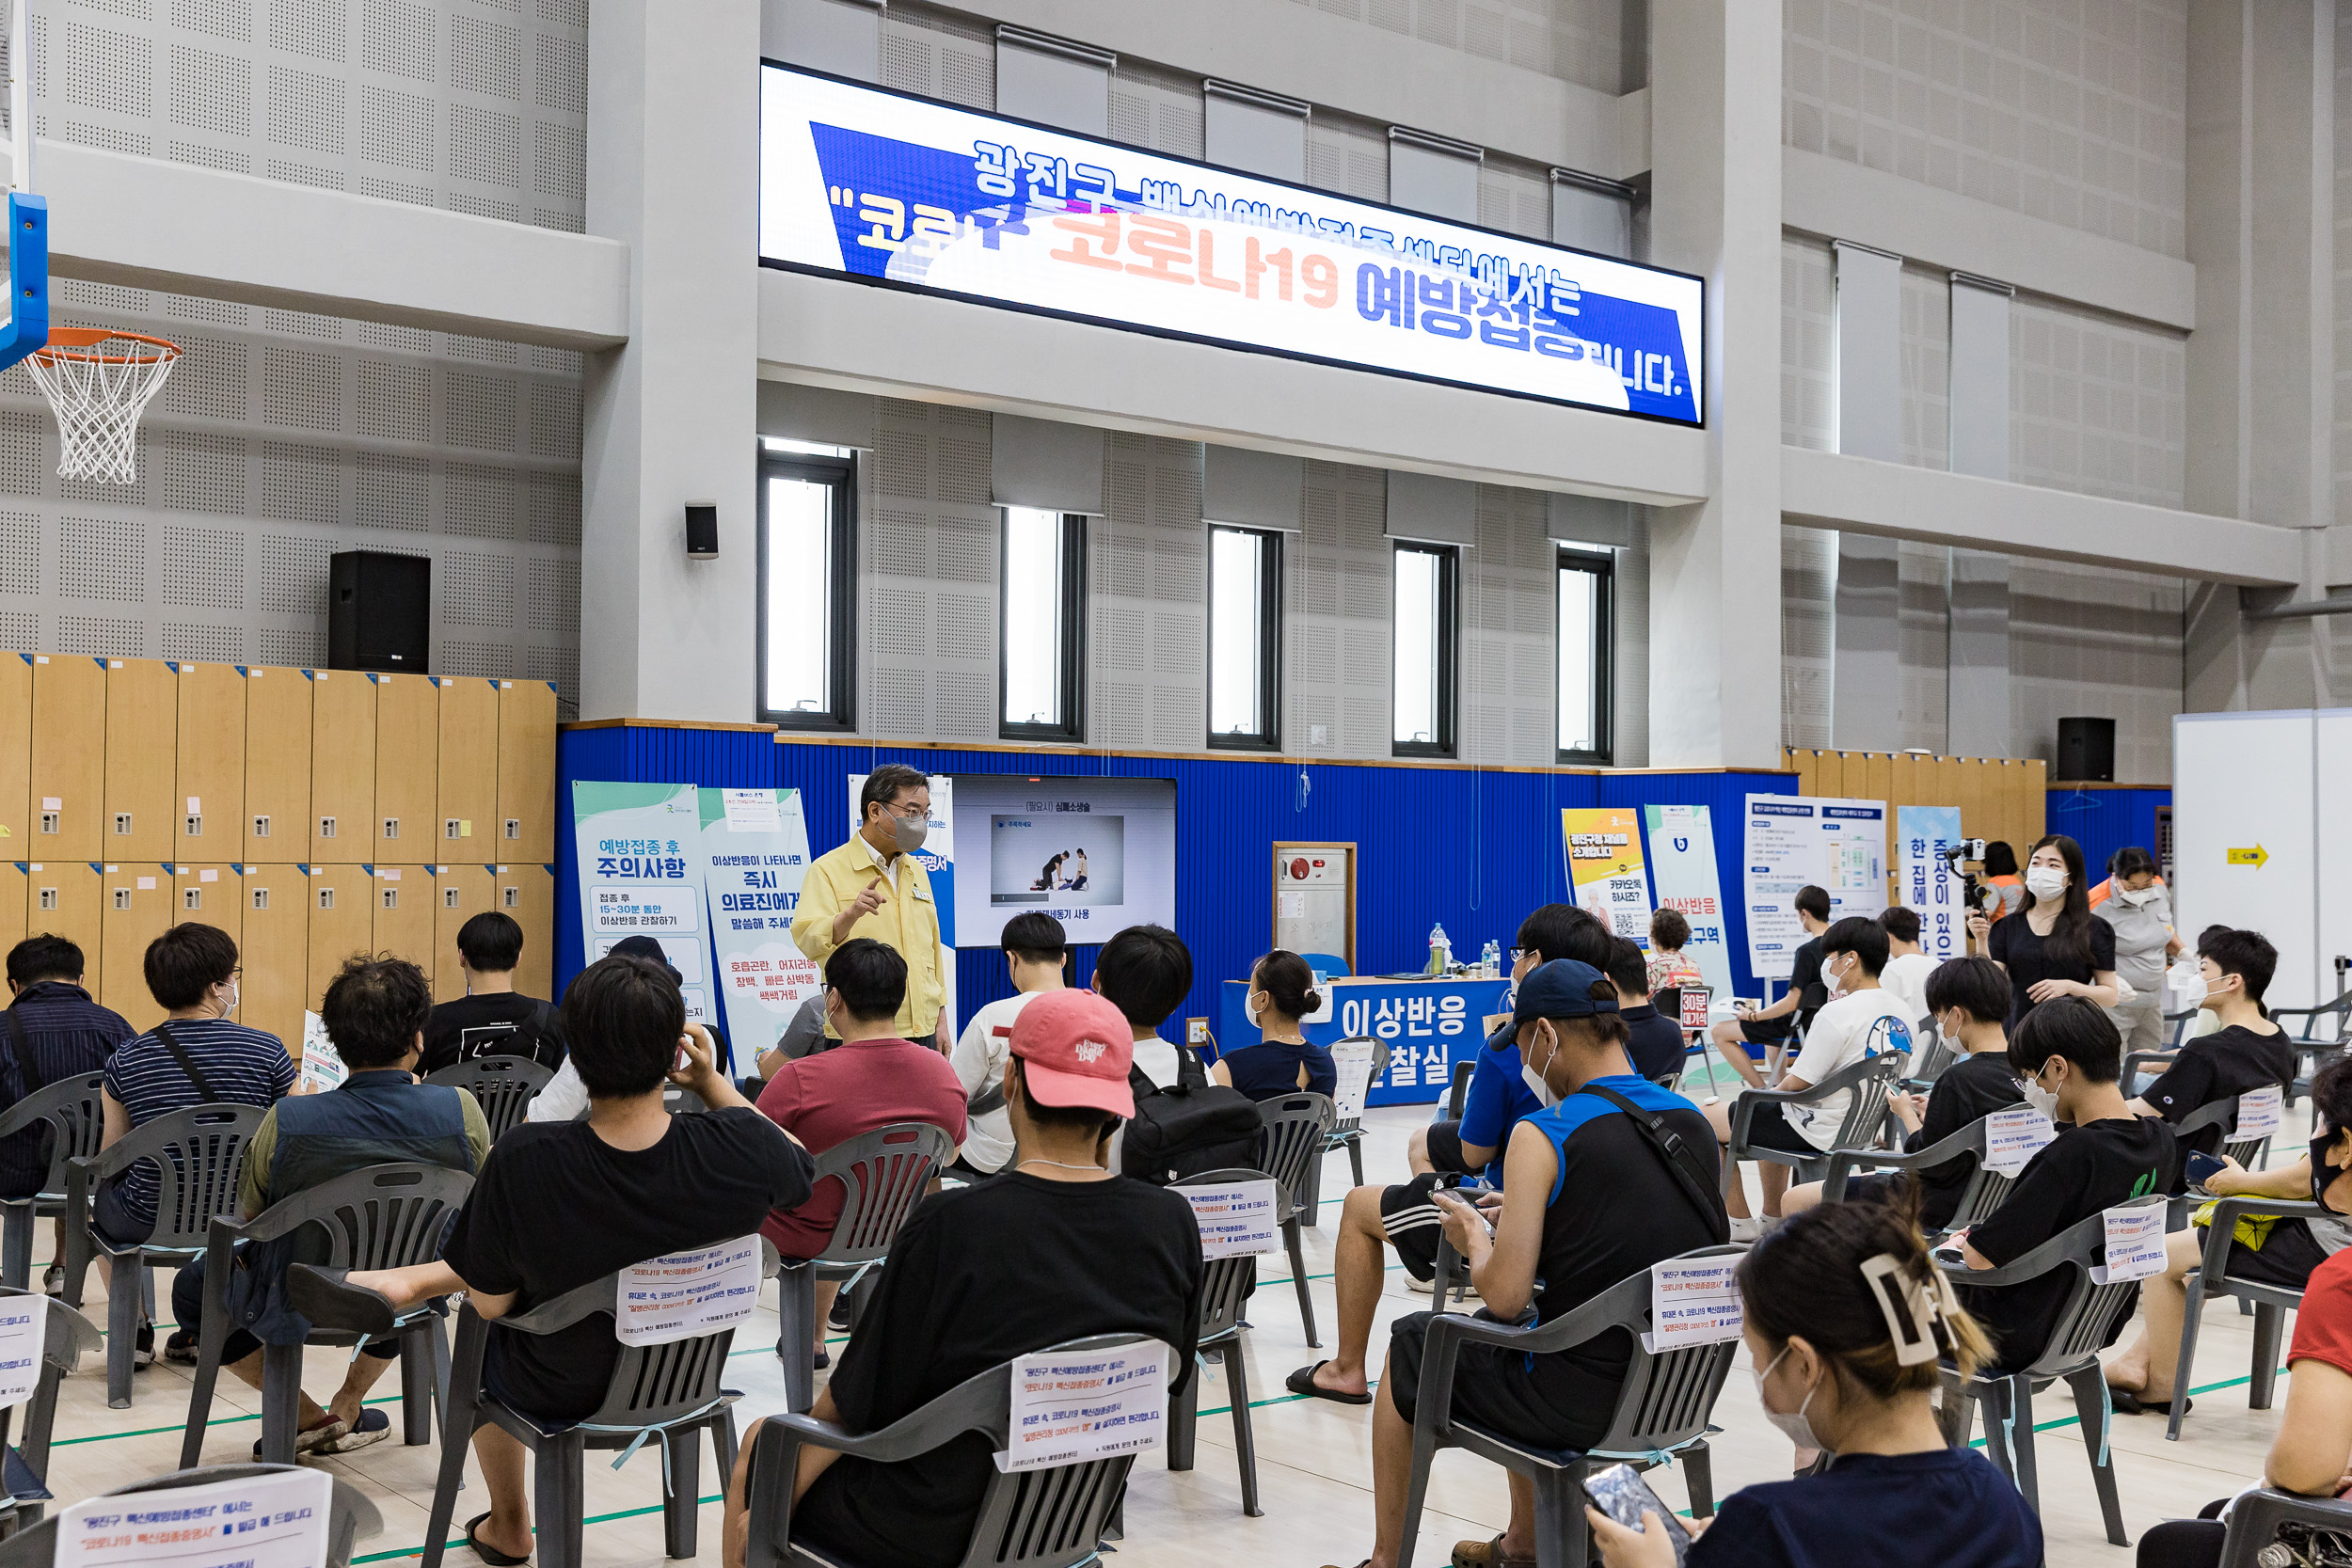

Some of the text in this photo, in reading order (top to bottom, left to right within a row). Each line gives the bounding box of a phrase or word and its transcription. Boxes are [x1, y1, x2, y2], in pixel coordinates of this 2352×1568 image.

[974, 140, 1116, 214] 광진구
[1049, 213, 1340, 309] 코로나19
[1356, 262, 1585, 361] 예방접종
[1025, 801, 1090, 813] (필요시) 심폐소생술
[1008, 820, 1032, 829] 주목하세요
[599, 839, 680, 856] 예방접종 후
[1911, 838, 1926, 859] 한
[712, 854, 802, 866] 이상반응이 나타나면
[596, 857, 686, 879] 주의사항
[1933, 839, 1949, 905] 증상이
[743, 871, 777, 889] 즉시
[1610, 879, 1642, 890] 카카오톡
[1912, 865, 1927, 906] 집에
[599, 894, 630, 903] 접종 후
[1612, 892, 1640, 902] 하시죠?
[599, 904, 661, 914] 15~30분 동안
[1662, 898, 1716, 914] 이상반응
[600, 915, 677, 927] 이상반응 관찰하기
[1073, 909, 1089, 919] 사용
[731, 917, 764, 930] 말씀해
[731, 959, 817, 973] 호흡곤란, 어지러움
[736, 974, 815, 988] 창백, 빠른 심박동
[759, 990, 798, 1001] 쌕쌕거림
[1682, 993, 1708, 1012] 30분
[1342, 994, 1467, 1039] 이상반응
[1682, 1011, 1708, 1026] 대기석
[1372, 1043, 1449, 1089] 찰실
[1052, 1409, 1078, 1421] 코로나19
